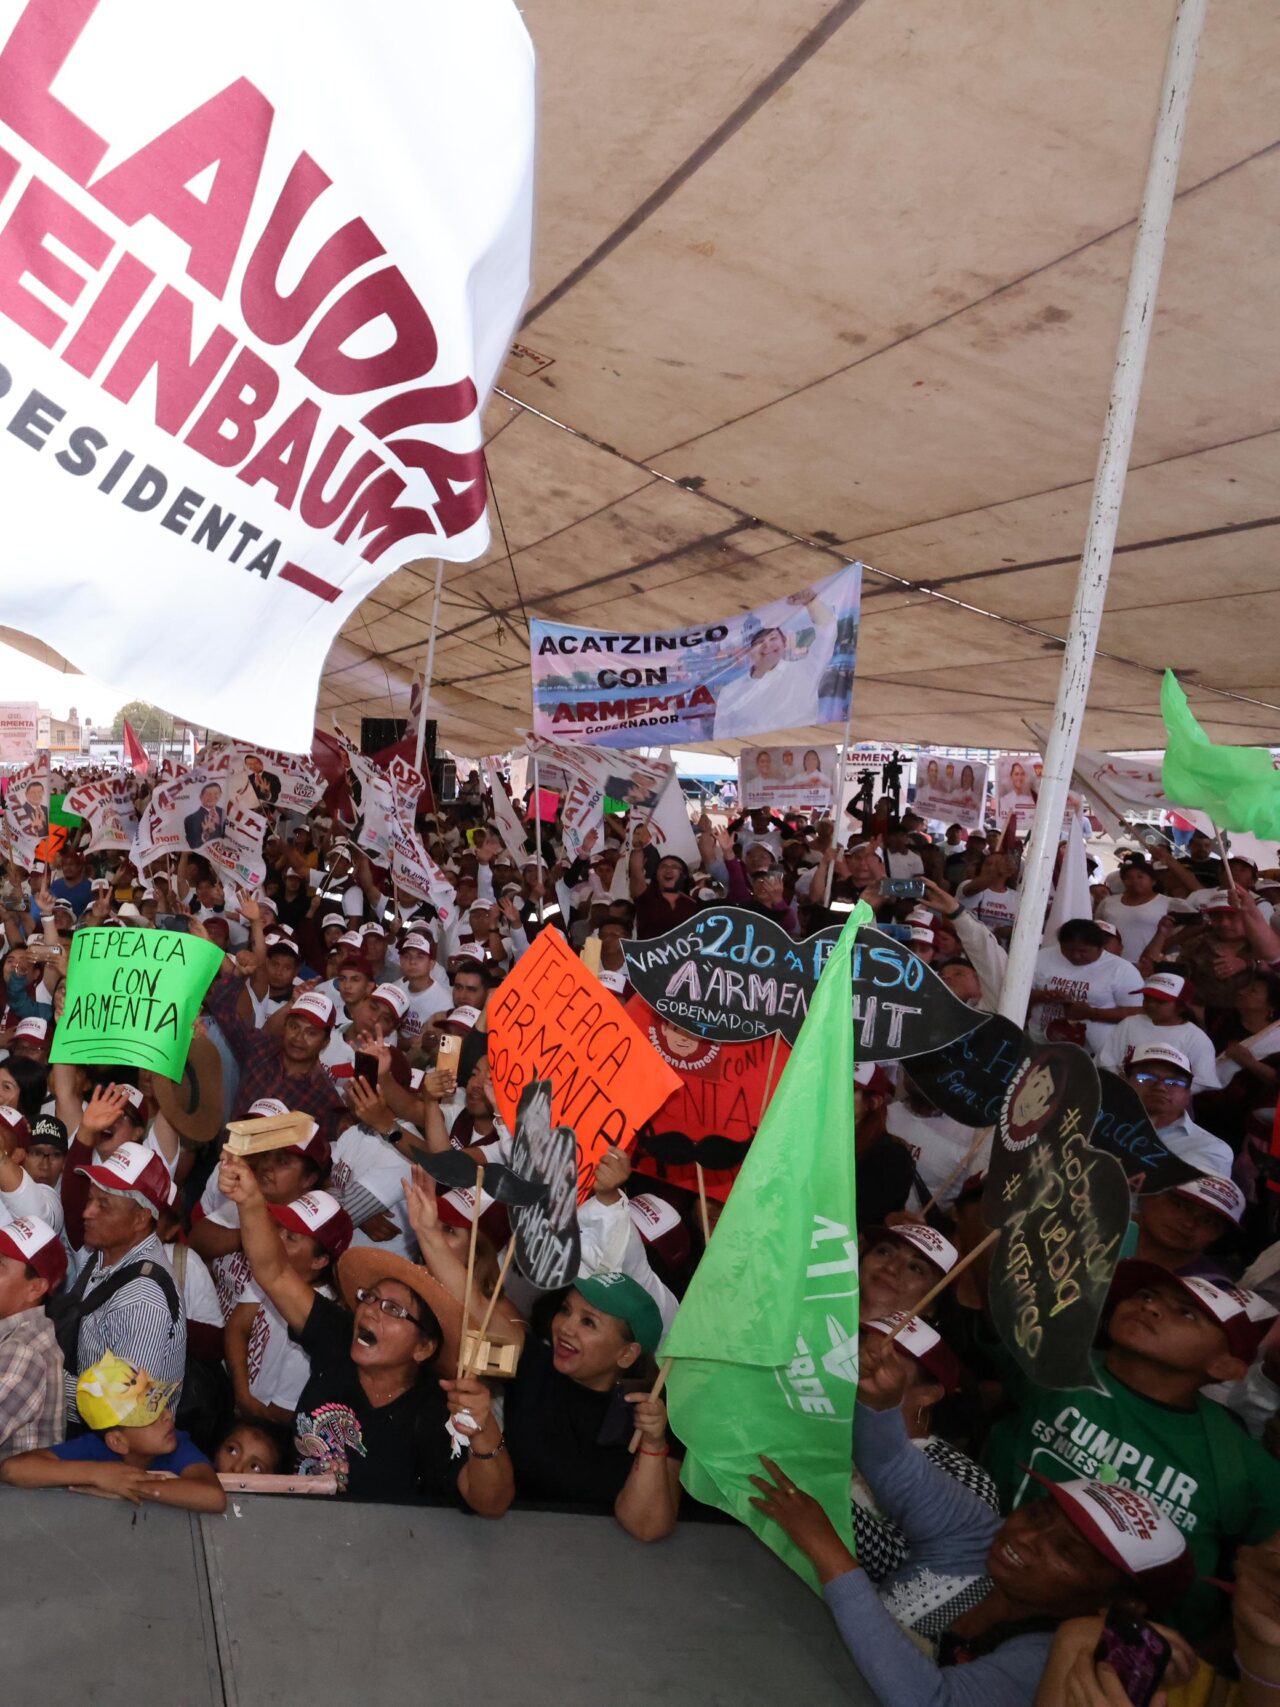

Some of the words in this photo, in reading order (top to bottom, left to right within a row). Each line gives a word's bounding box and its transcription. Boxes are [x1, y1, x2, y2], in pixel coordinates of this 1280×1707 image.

[538, 625, 729, 655] ACATZINGO
[597, 666, 668, 689] CON
[552, 685, 717, 724] ARMENTA
[585, 714, 680, 735] GOBERNADOR
[78, 930, 186, 966] TEPEACA
[113, 967, 162, 997] CON
[66, 993, 178, 1040] ARMENTA
[523, 933, 632, 1087] TEPEACA
[656, 998, 769, 1035] GOBERNADOR
[495, 988, 627, 1152] ARMENTA
[1031, 1419, 1057, 1443] ES
[1054, 1406, 1198, 1509] CUMPLIR
